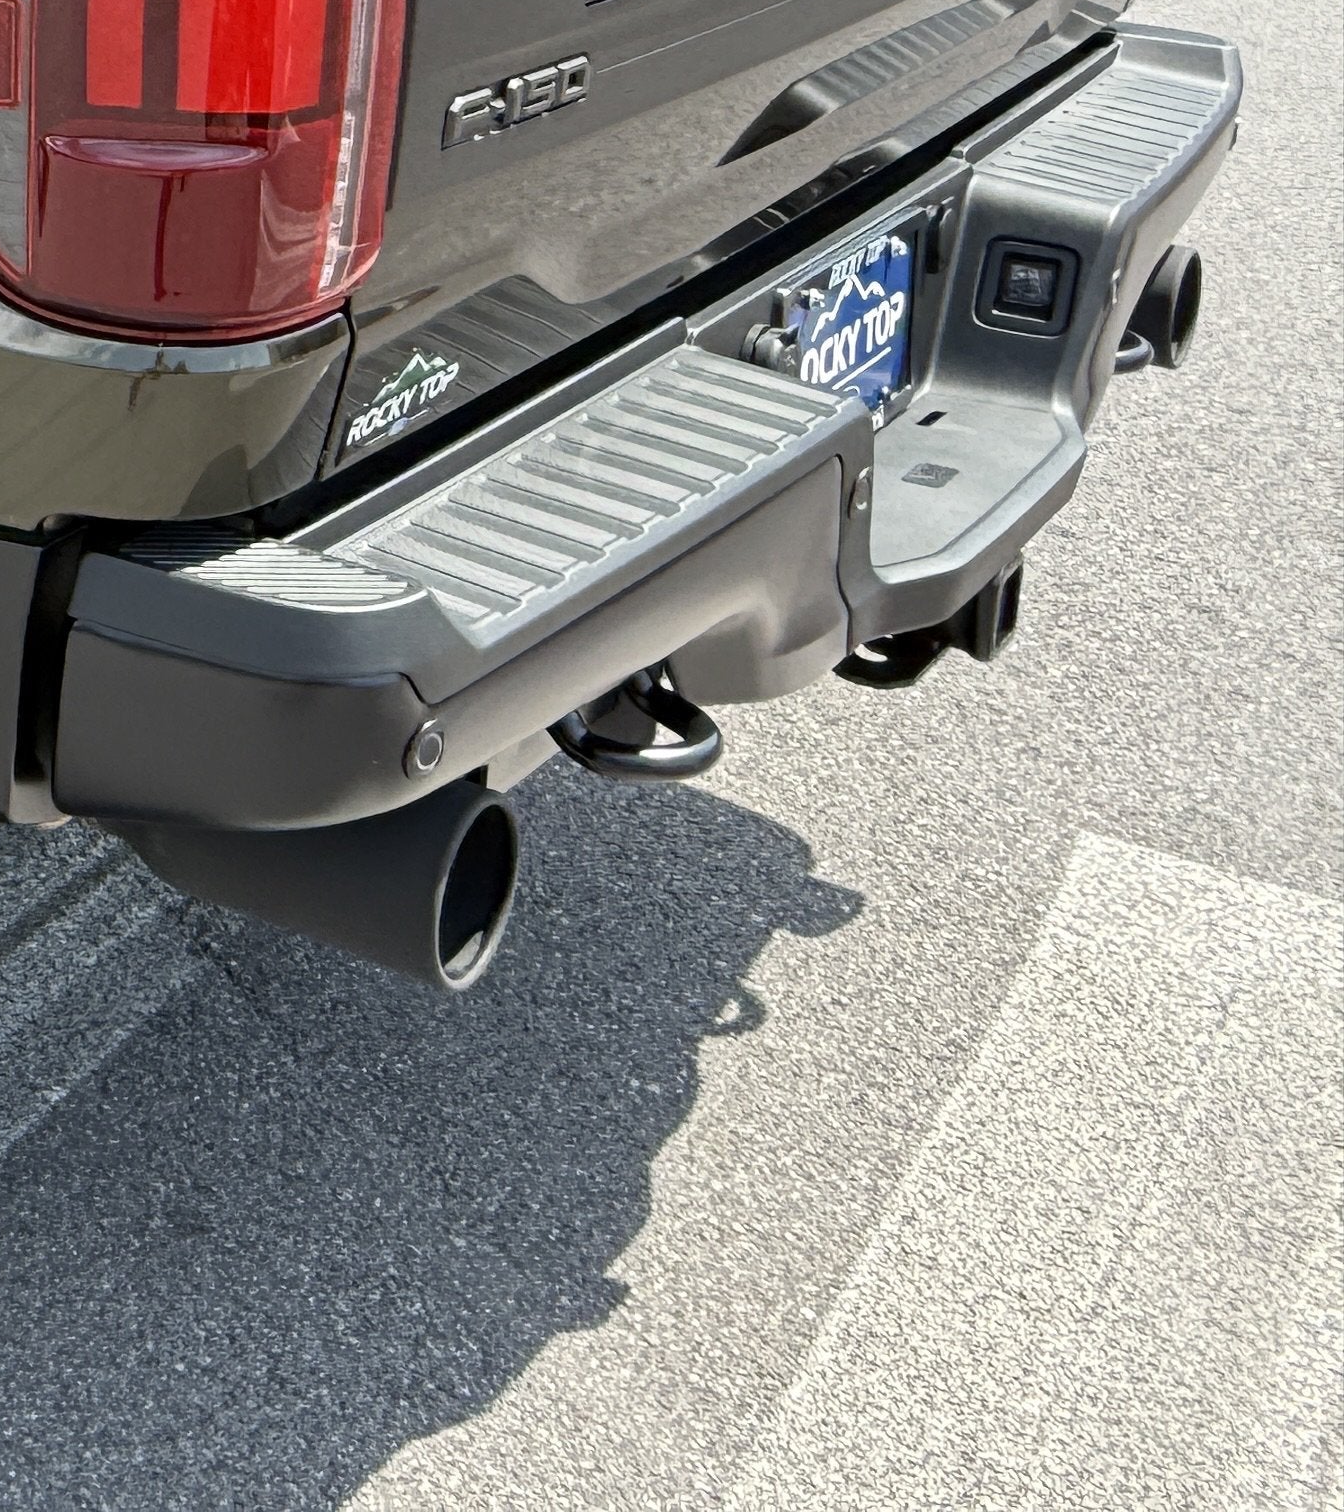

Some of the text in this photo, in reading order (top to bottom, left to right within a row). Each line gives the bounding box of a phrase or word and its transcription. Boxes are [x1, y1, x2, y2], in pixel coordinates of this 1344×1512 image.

[441, 52, 591, 151] F-150
[800, 291, 905, 385] OCKY TOP
[346, 361, 460, 447] ROCKY TOP
